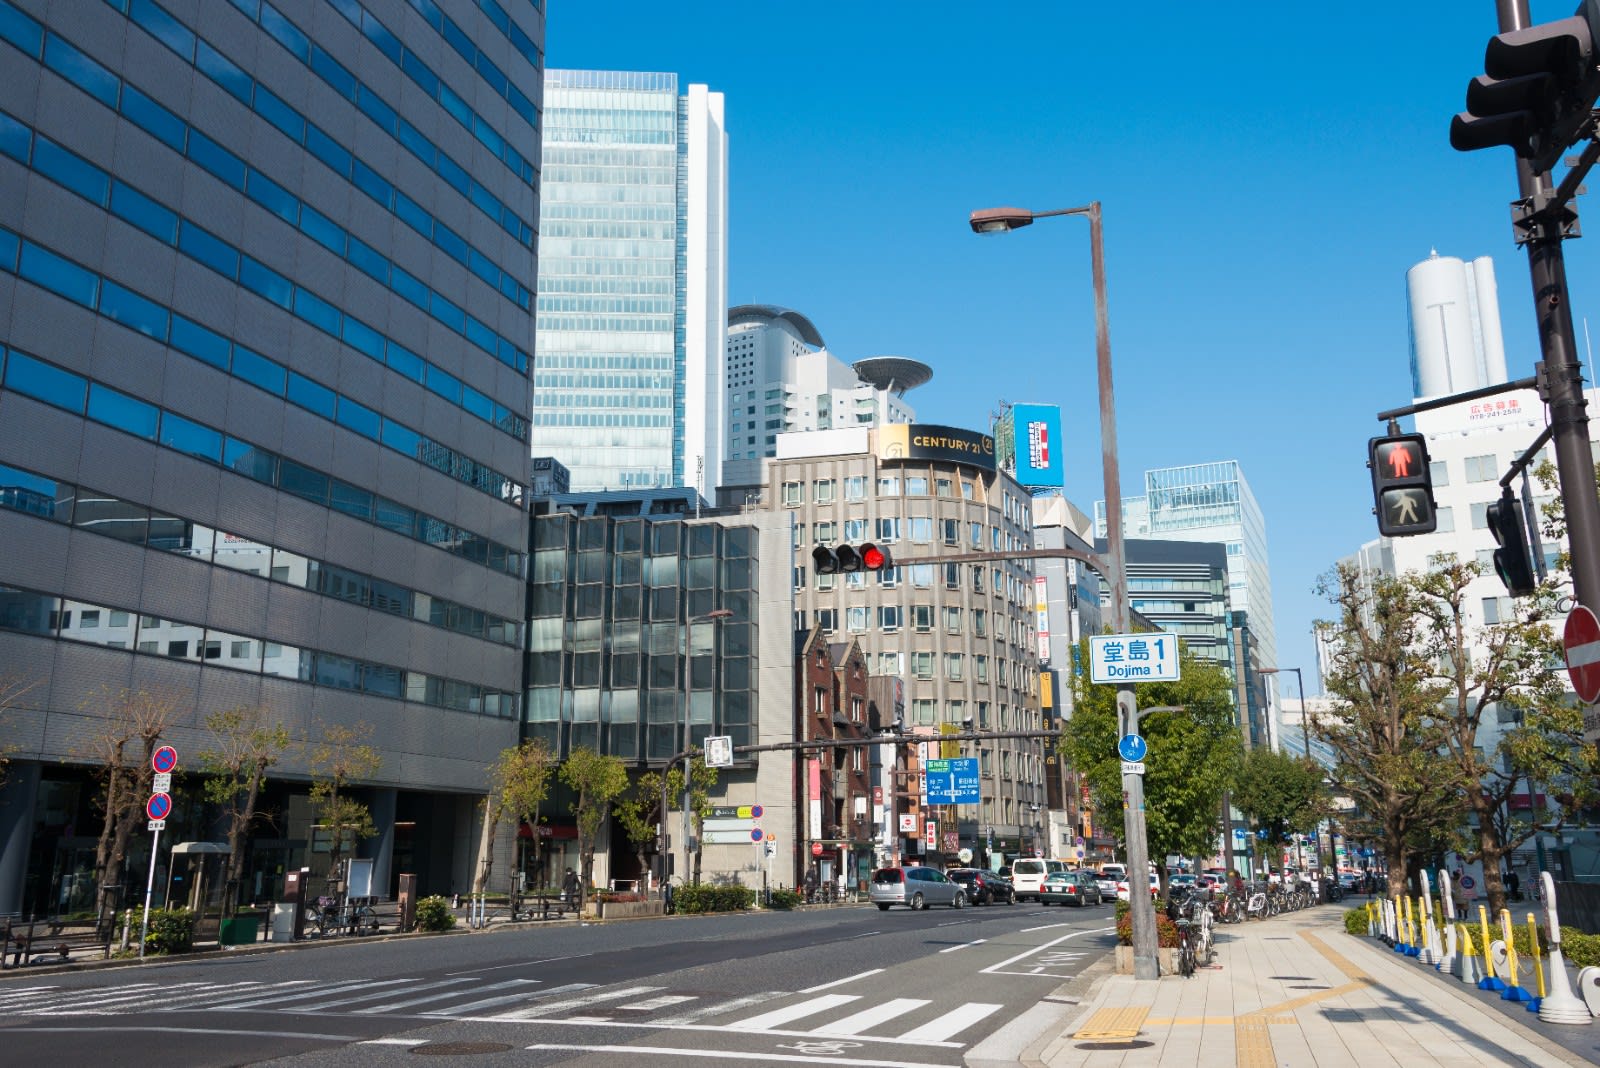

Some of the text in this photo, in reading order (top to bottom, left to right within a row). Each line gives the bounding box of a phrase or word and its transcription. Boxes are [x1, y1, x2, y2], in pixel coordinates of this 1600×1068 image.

[1471, 400, 1518, 414] 広告募集
[913, 436, 980, 455] CENTURY 21
[891, 448, 903, 458] 21
[1107, 664, 1163, 678] Dojima 1
